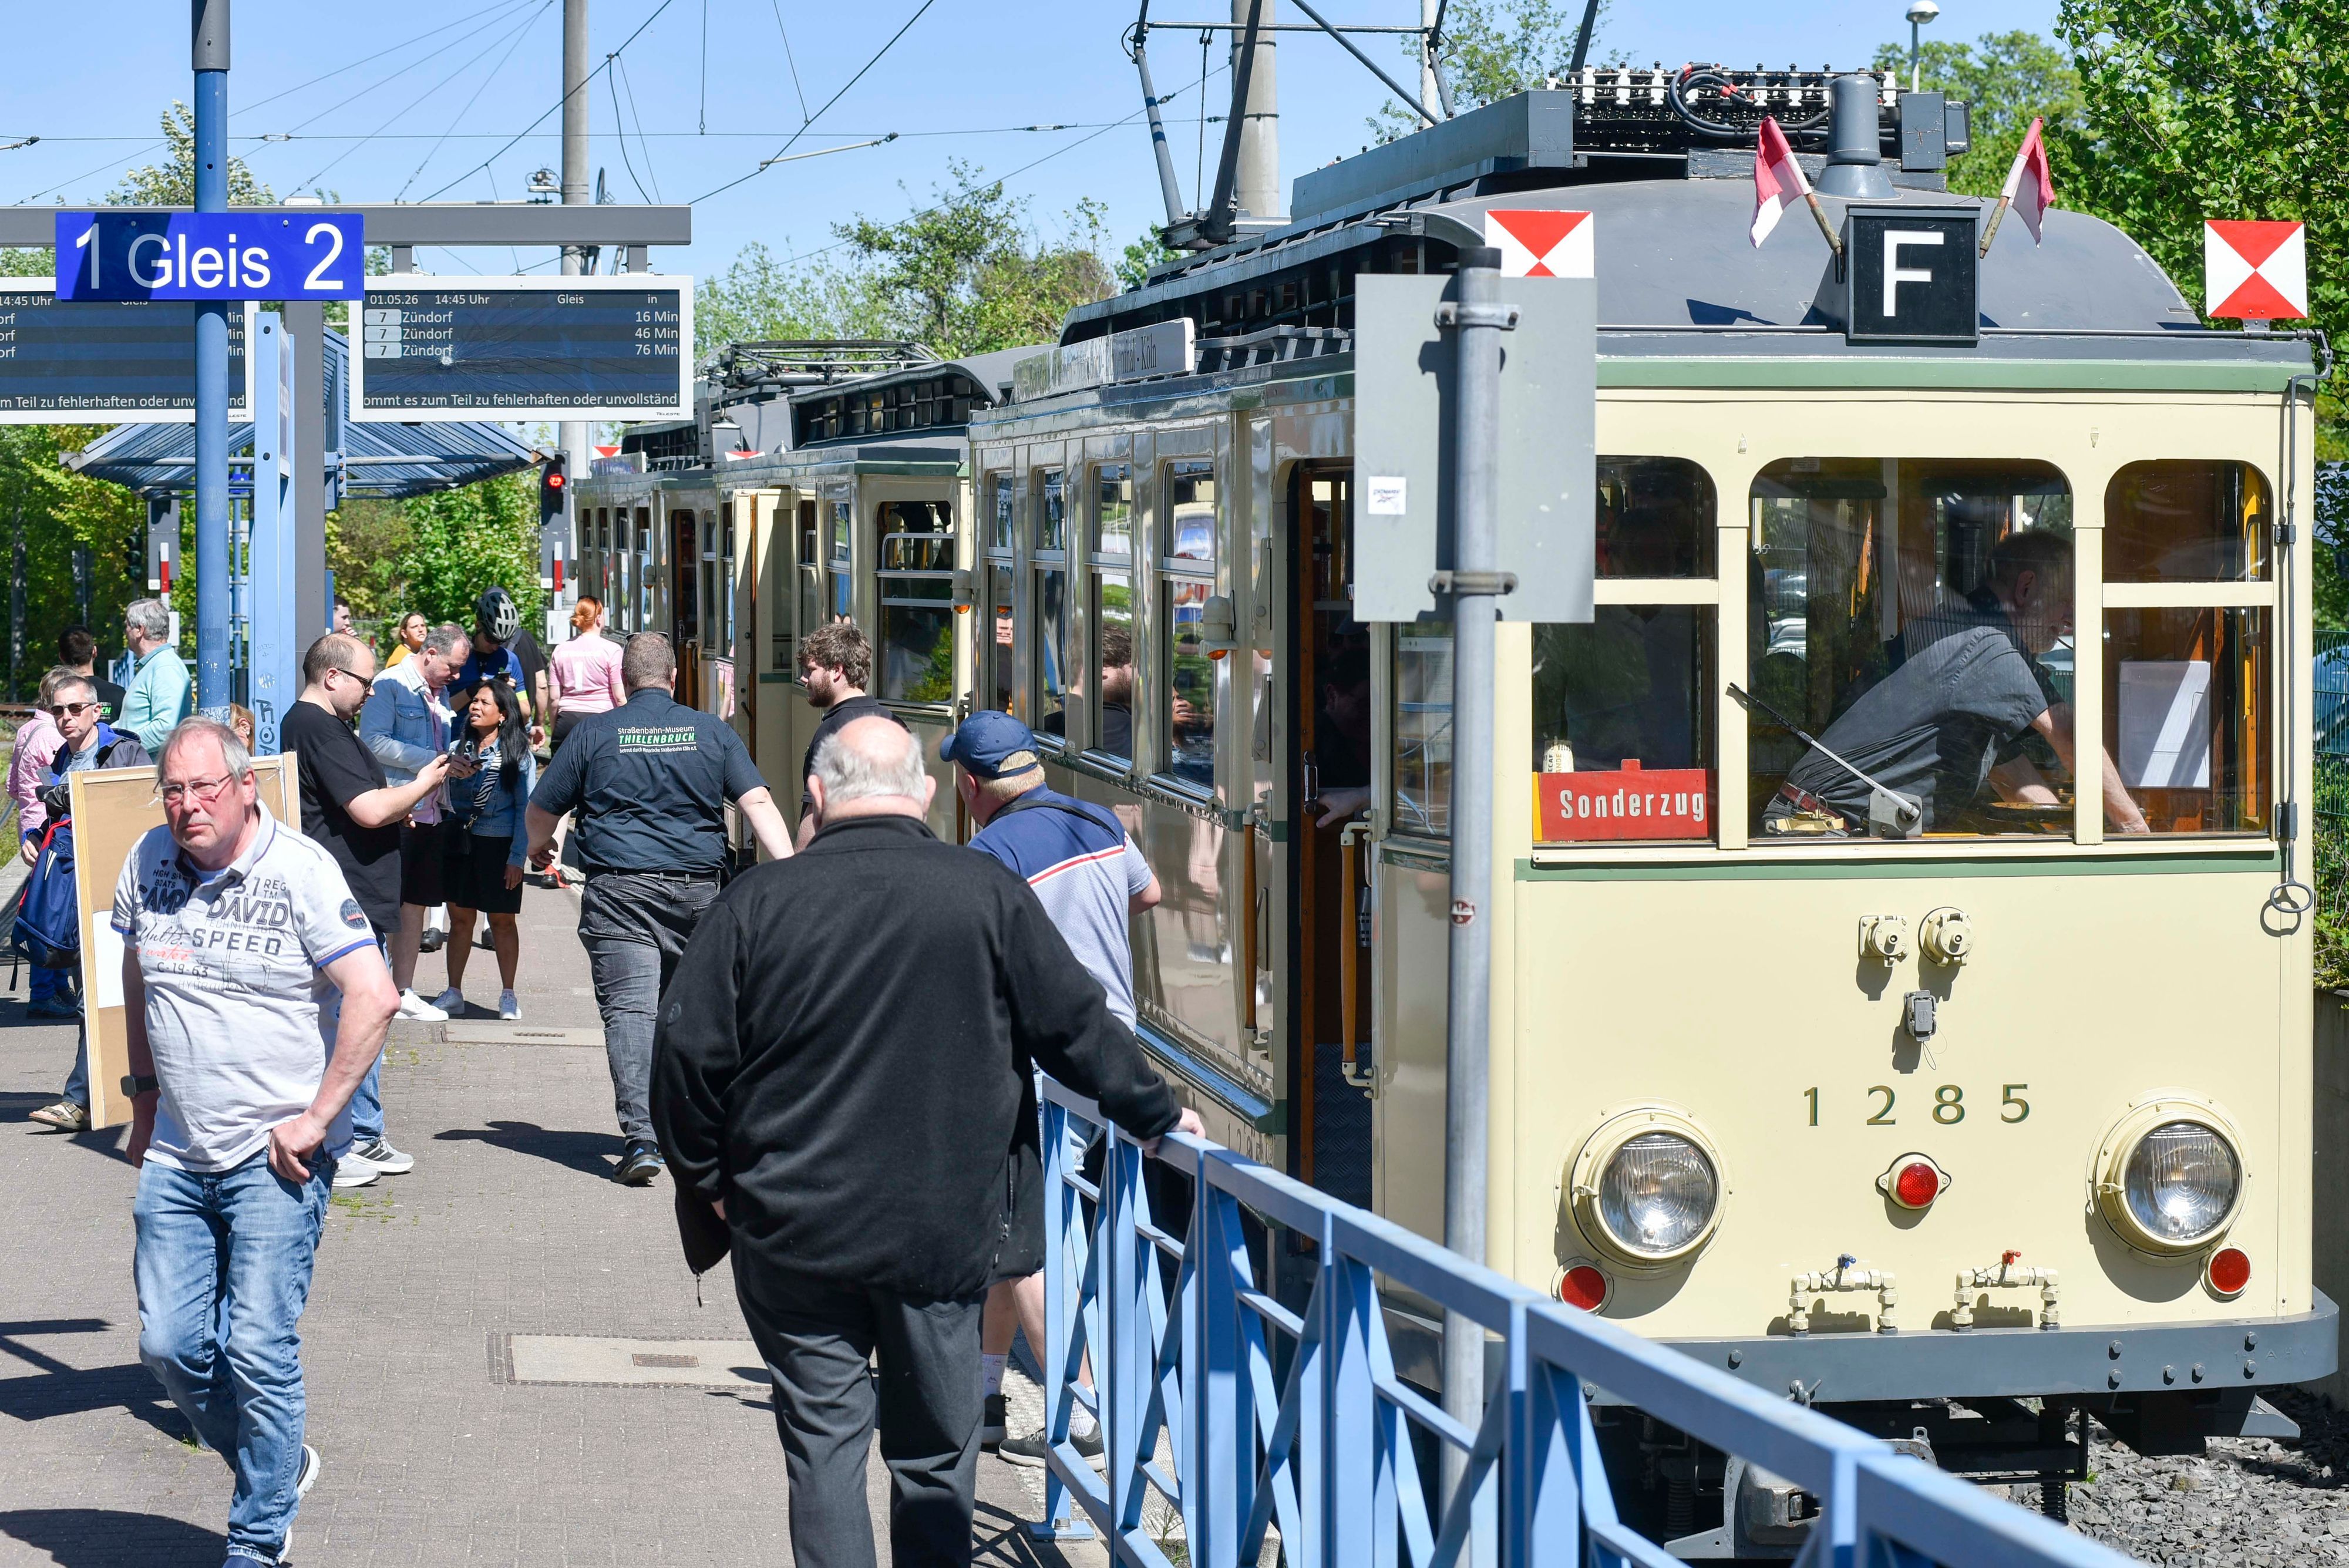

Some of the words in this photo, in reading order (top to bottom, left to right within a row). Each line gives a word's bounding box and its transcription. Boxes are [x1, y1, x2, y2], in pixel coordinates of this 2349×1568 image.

[76, 223, 99, 289] 1
[128, 234, 271, 288] Gleis
[304, 223, 344, 290] 2
[1883, 230, 1944, 317] F
[32, 296, 52, 306] Uhr
[370, 295, 418, 305] 01.05.26
[435, 295, 466, 304] 14:45
[469, 295, 490, 304] Uhr
[557, 294, 584, 304] Gleis
[648, 294, 657, 304] in
[379, 312, 386, 322] 7
[402, 311, 453, 323] Zündorf
[635, 311, 651, 322] 16
[655, 311, 678, 322] Min
[380, 329, 386, 339] 7
[402, 328, 453, 339] Zündorf
[635, 328, 651, 339] 46
[655, 328, 678, 339] Min
[380, 345, 386, 356] 7
[403, 344, 453, 356] Zündorf
[635, 344, 651, 355] 76
[655, 344, 678, 355] Min
[1141, 333, 1157, 370] Köln
[15, 396, 36, 408] Teil
[41, 399, 54, 408] zu
[58, 396, 135, 408] fehlerhaften
[139, 396, 169, 407] oder
[404, 397, 418, 405] es
[421, 397, 447, 405] zum
[451, 395, 472, 405] Teil
[476, 396, 489, 405] zu
[493, 393, 569, 405] fehlerhaften
[573, 393, 603, 405] oder
[620, 733, 695, 743] THIELENBRUCH
[1560, 788, 1704, 822] Sonderzug
[153, 869, 170, 878] HIGH
[264, 879, 287, 891] REG
[264, 890, 278, 900] TM
[136, 884, 186, 914] CAMP
[206, 894, 288, 927] DAVID
[192, 928, 281, 955] SPEED
